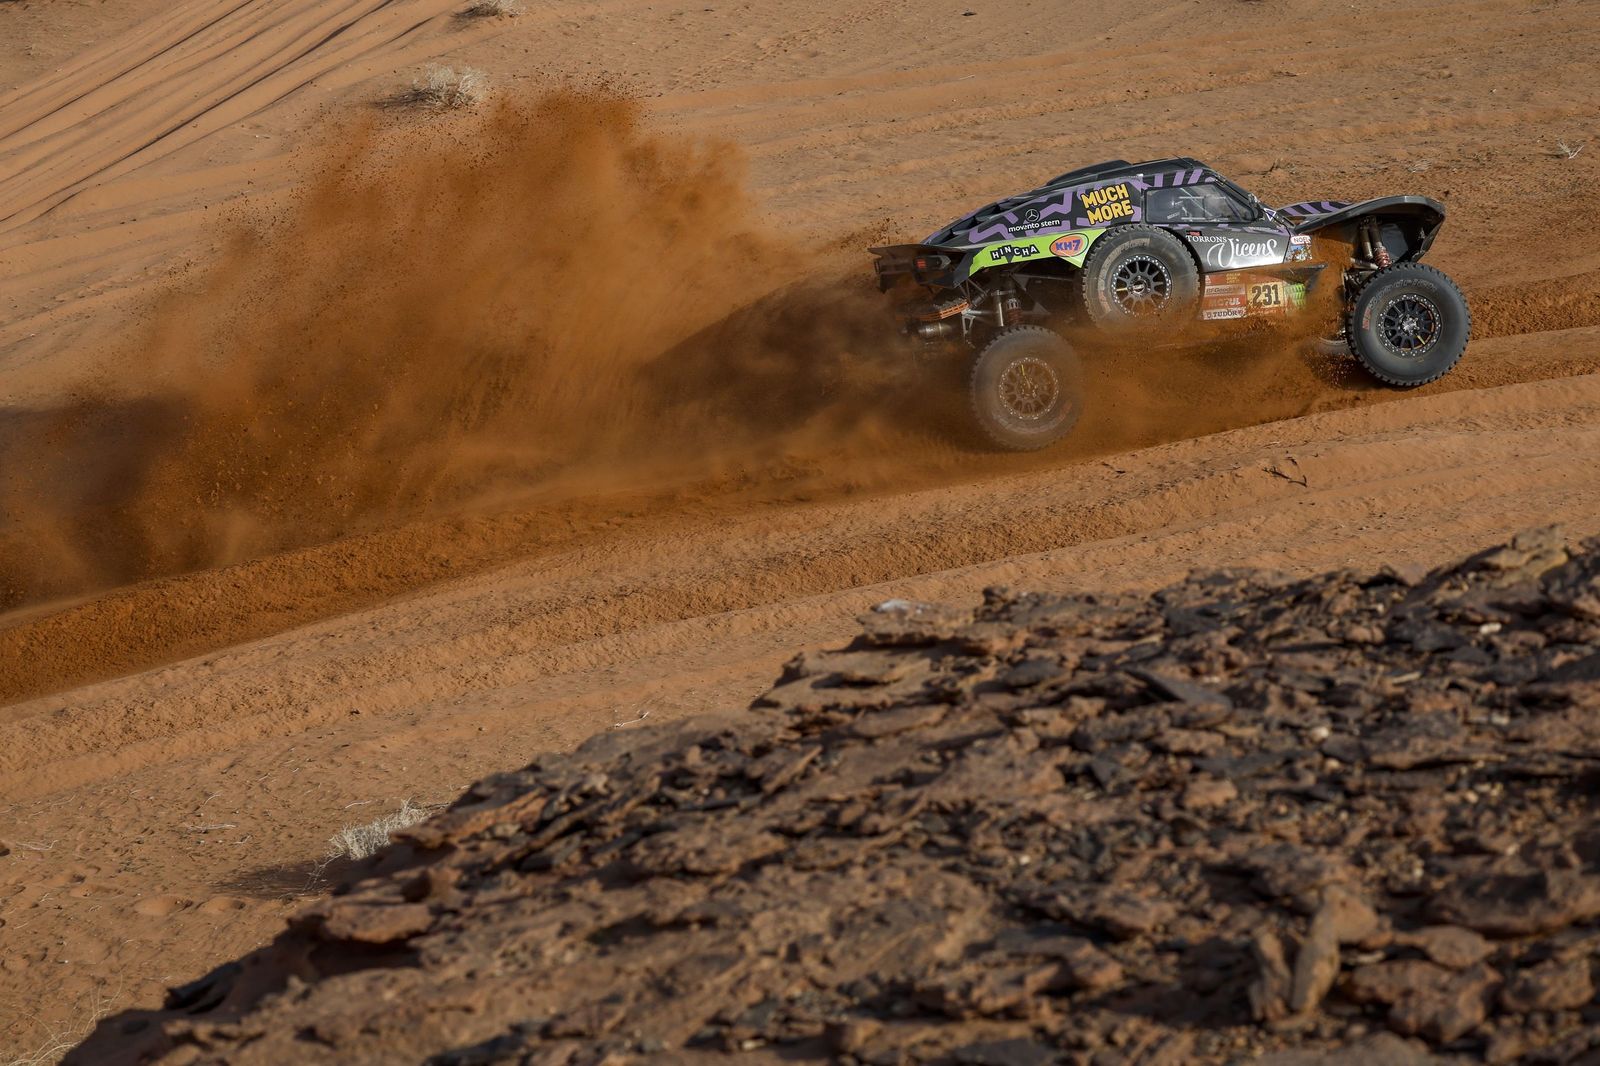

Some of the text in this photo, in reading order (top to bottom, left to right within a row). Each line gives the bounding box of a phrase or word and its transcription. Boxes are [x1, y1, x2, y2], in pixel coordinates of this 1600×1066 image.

[1081, 183, 1129, 208] MUCH
[1040, 219, 1060, 227] stern
[1087, 200, 1134, 225] MORE
[992, 246, 1038, 259] HINCHA
[1207, 238, 1277, 268] Vicens
[1252, 284, 1280, 306] 231
